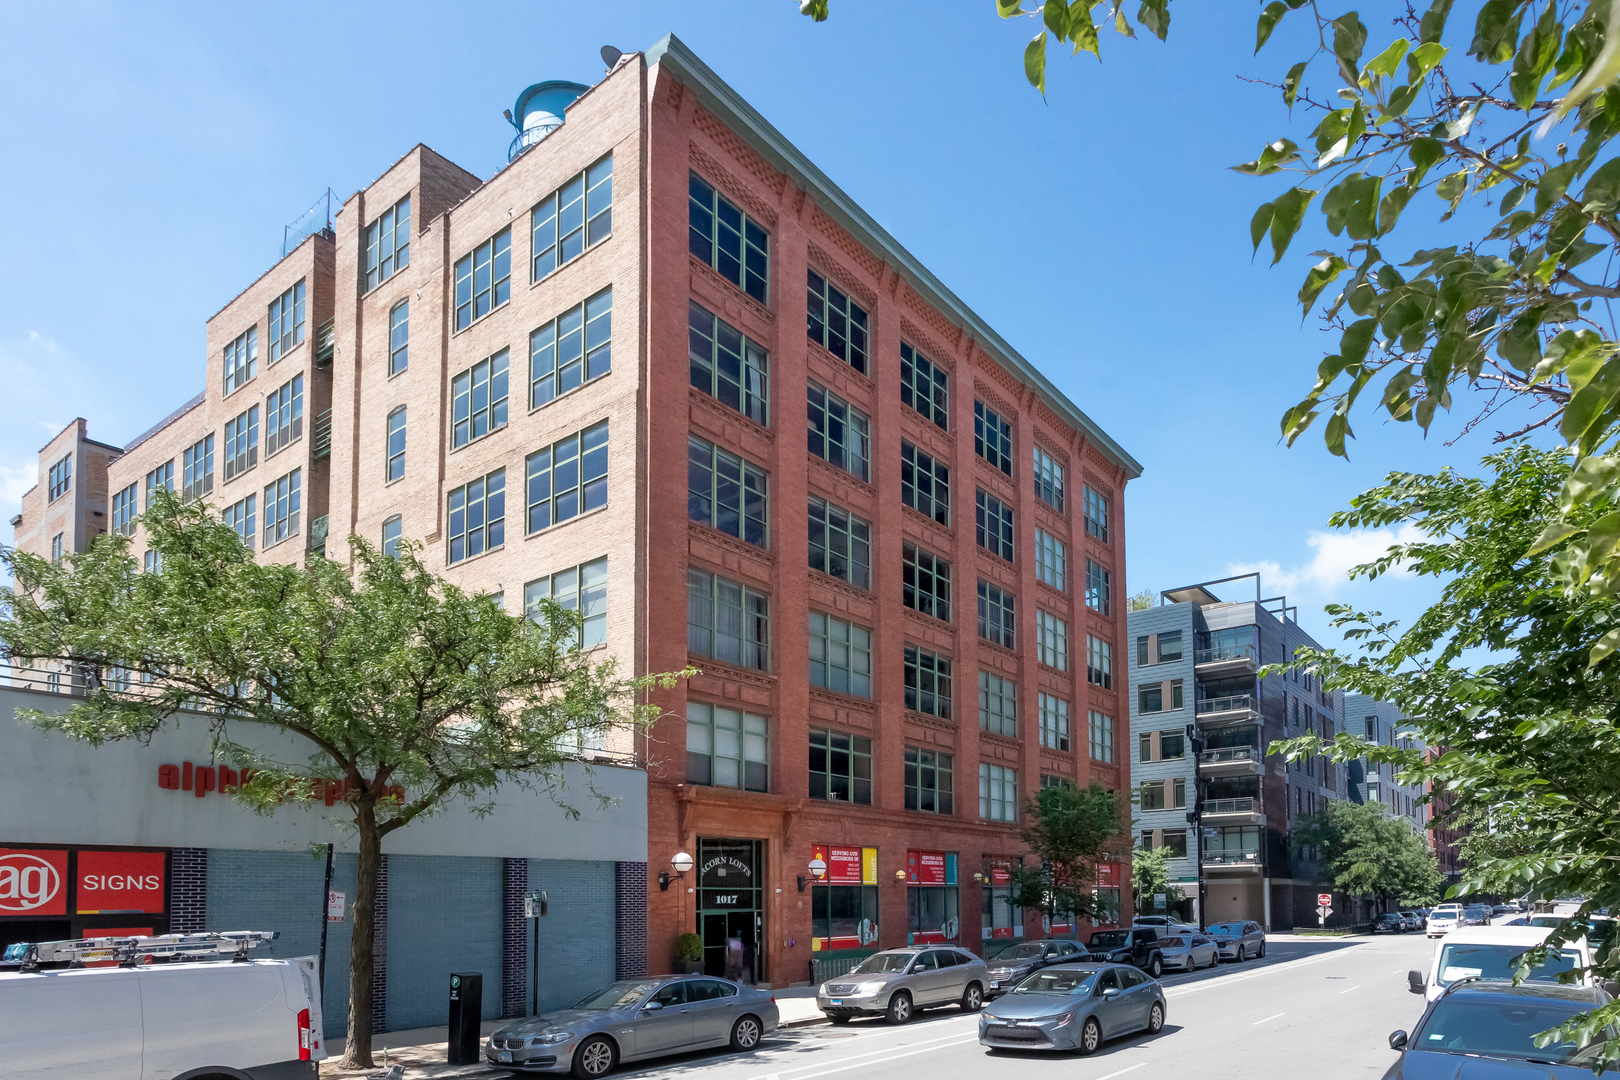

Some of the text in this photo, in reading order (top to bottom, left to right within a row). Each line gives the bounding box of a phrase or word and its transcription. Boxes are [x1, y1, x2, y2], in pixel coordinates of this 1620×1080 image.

[158, 761, 405, 806] alphaps
[701, 856, 751, 877] ACORN LOFTS
[83, 875, 160, 890] SIGNS
[716, 895, 738, 904] 1017
